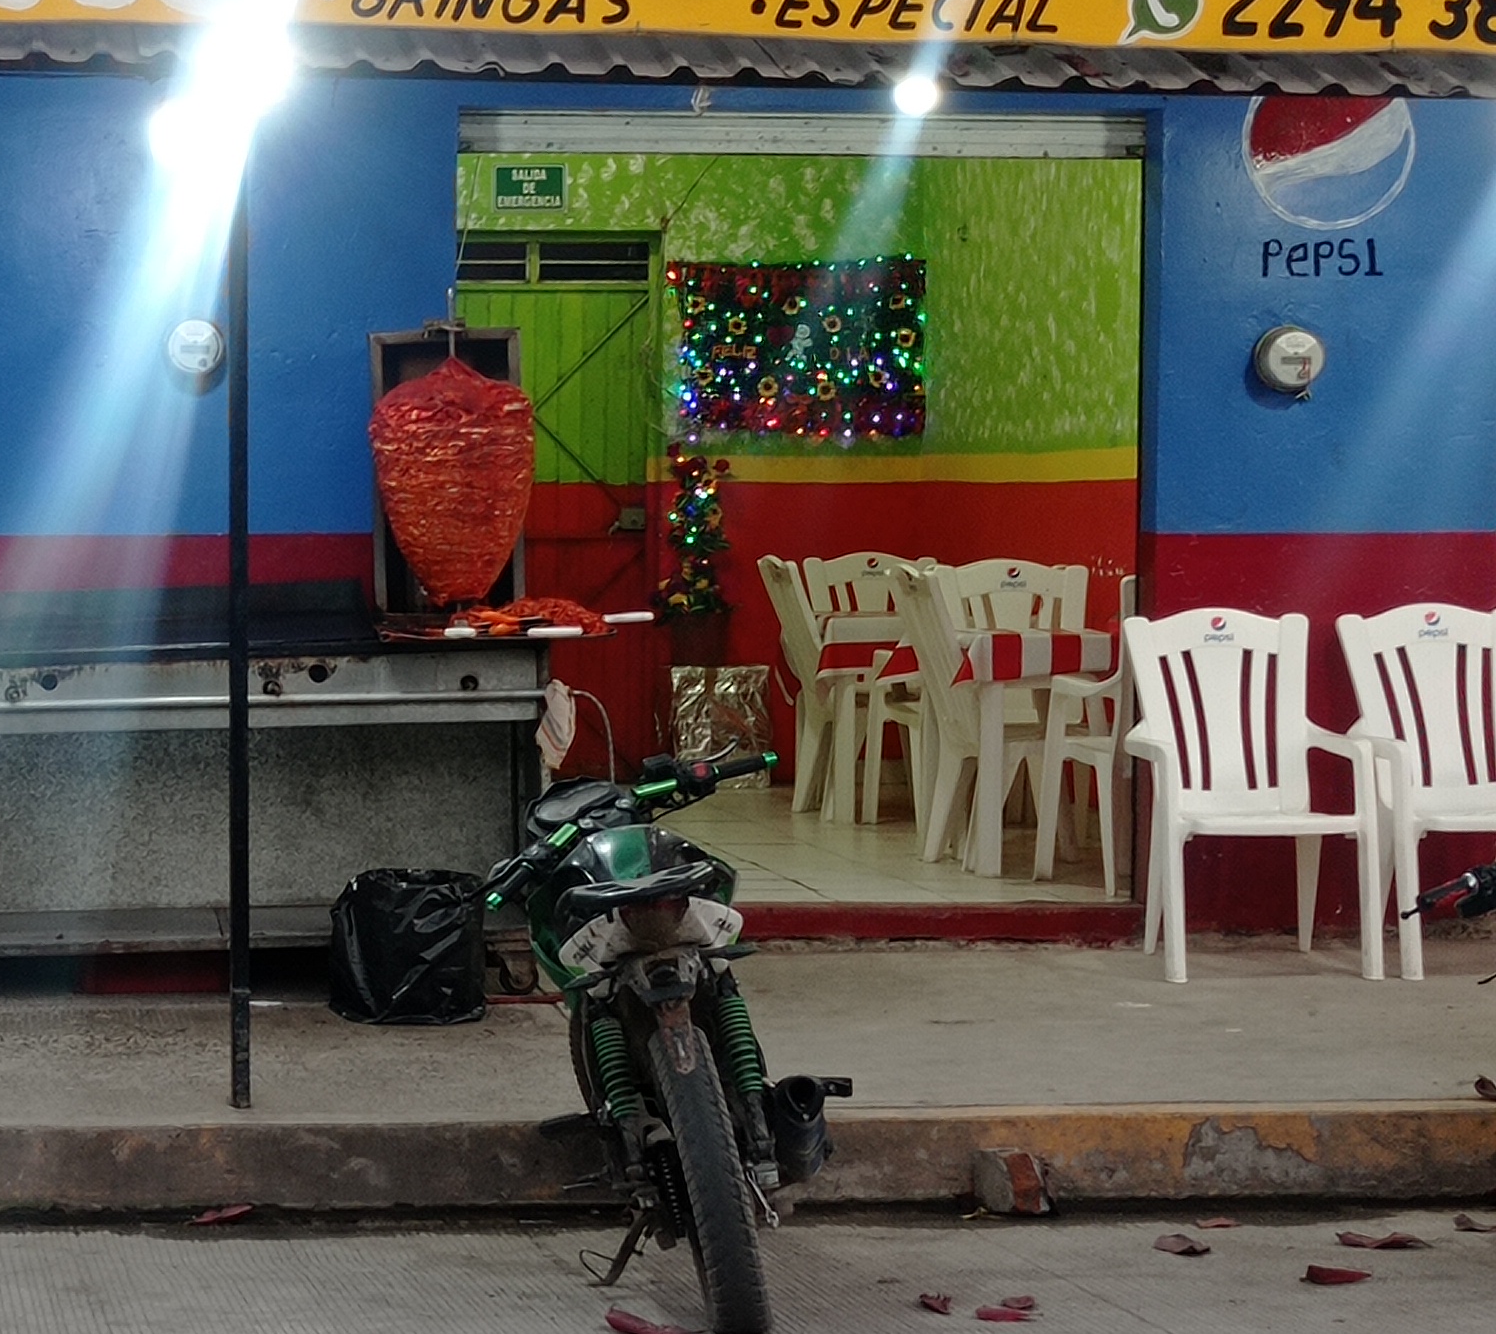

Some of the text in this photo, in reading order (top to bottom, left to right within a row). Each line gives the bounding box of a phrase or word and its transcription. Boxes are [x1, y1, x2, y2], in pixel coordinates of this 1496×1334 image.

[511, 168, 547, 181] SALIDA
[522, 181, 537, 194] DE
[1203, 632, 1235, 643] pepsi
[1417, 627, 1449, 639] pepsi
